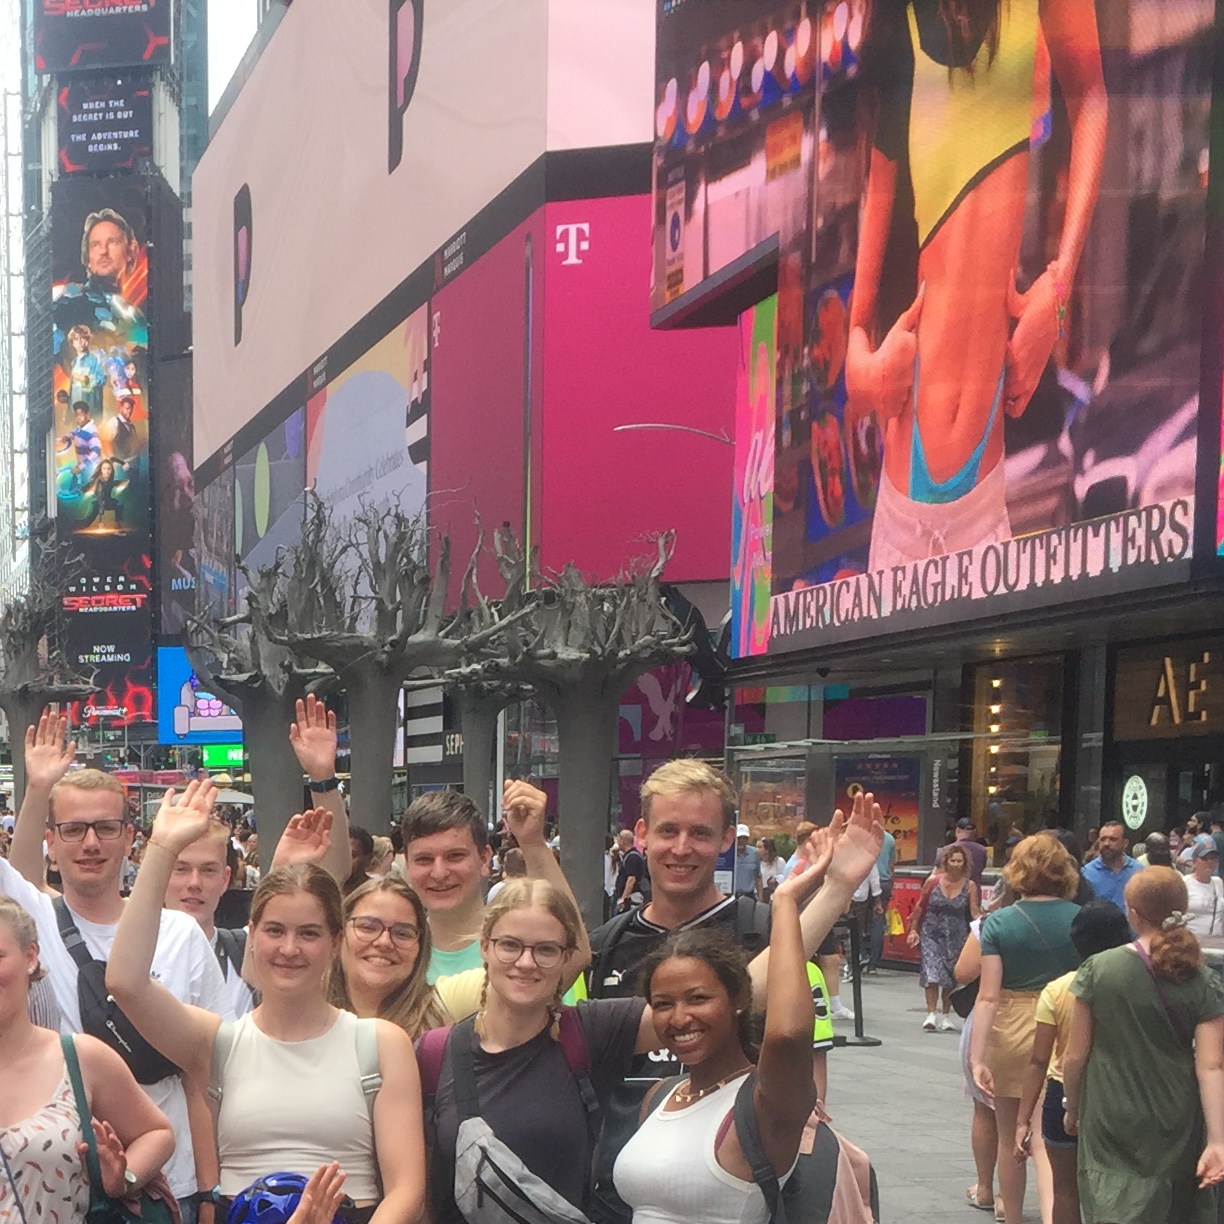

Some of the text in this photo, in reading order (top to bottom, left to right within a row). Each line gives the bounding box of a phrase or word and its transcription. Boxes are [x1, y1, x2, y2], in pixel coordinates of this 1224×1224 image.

[66, 4, 148, 17] HEADQUARTERS
[82, 99, 124, 109] WHEN THE
[72, 110, 134, 122] SECRET IS OUT
[71, 130, 140, 142] THE ADVENTURE
[556, 223, 590, 265] T
[771, 498, 1189, 638] AMERICAN EAGLE OUTFITTERS
[80, 576, 125, 584] OWEN
[68, 584, 137, 592] WILSON
[62, 594, 148, 611] SECRET
[78, 605, 136, 613] HEADQUARTERS
[93, 645, 116, 653] NOW
[78, 653, 131, 664] STREAMING
[1150, 651, 1211, 727] AE
[932, 759, 942, 809] Newsstand
